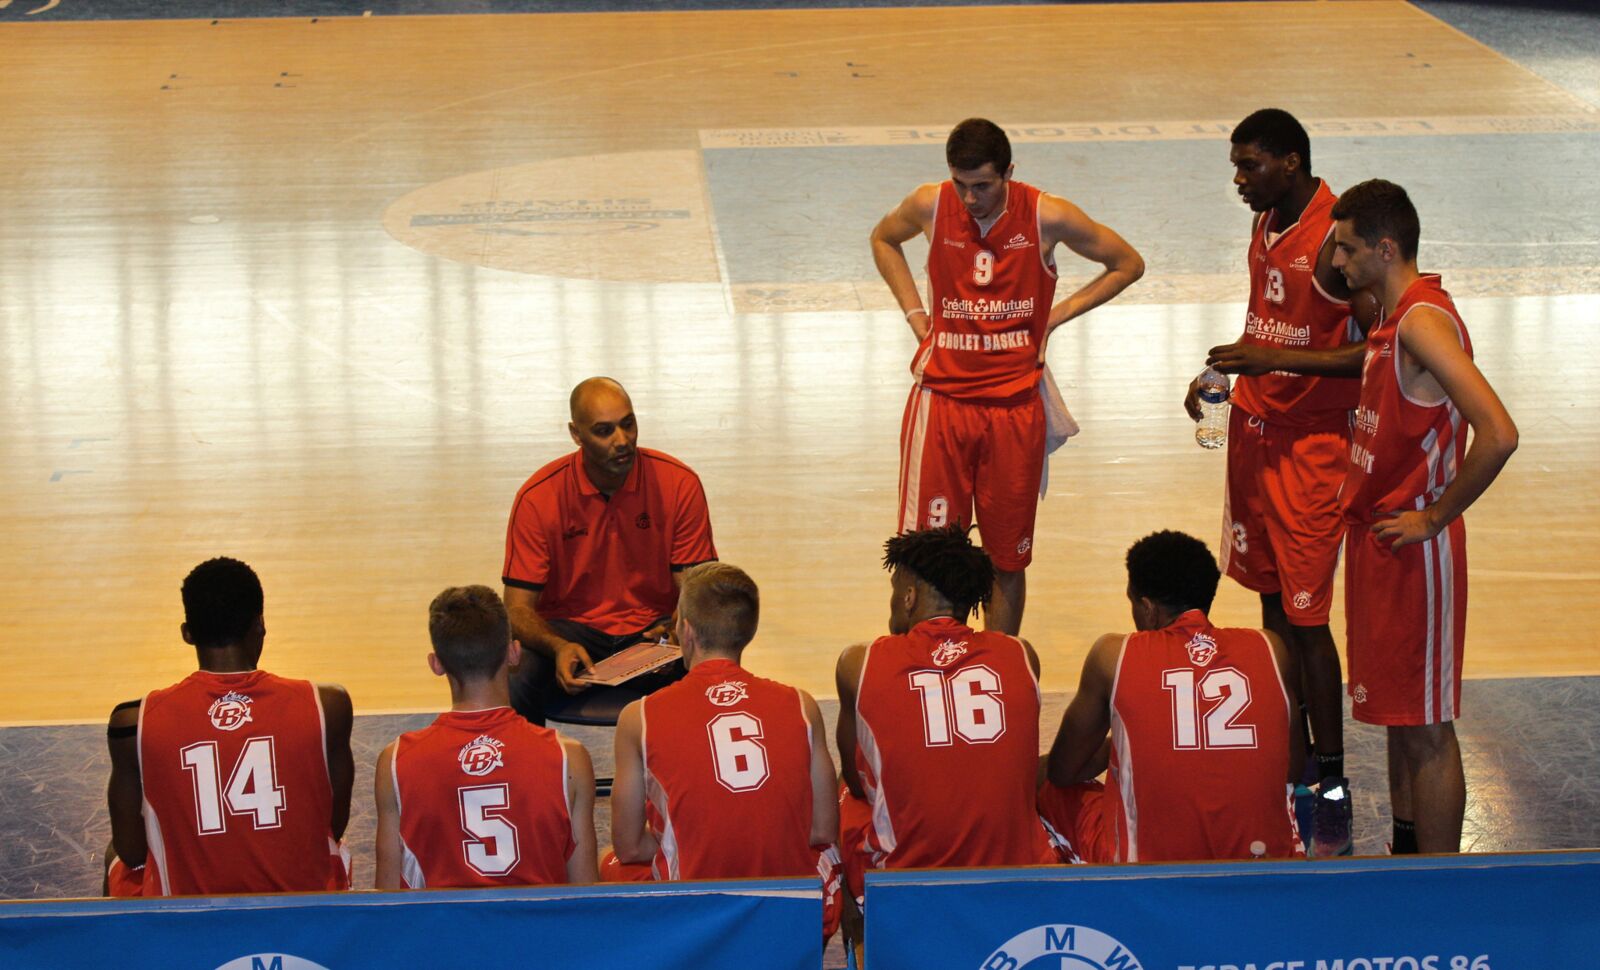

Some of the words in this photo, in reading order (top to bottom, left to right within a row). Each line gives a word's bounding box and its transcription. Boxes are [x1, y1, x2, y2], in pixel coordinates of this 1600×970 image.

[1184, 120, 1435, 134] L'ESIT
[973, 249, 995, 286] 9
[942, 297, 973, 312] Crédit
[989, 297, 1034, 313] Mutuel
[937, 331, 979, 351] CHOLET
[983, 330, 1031, 351] BASKET
[926, 496, 950, 528] 9
[1231, 521, 1249, 554] 3
[908, 664, 1007, 748] 16
[1161, 667, 1259, 751] 12
[707, 711, 771, 793] 6
[180, 734, 286, 836] 14
[456, 783, 521, 877] 5
